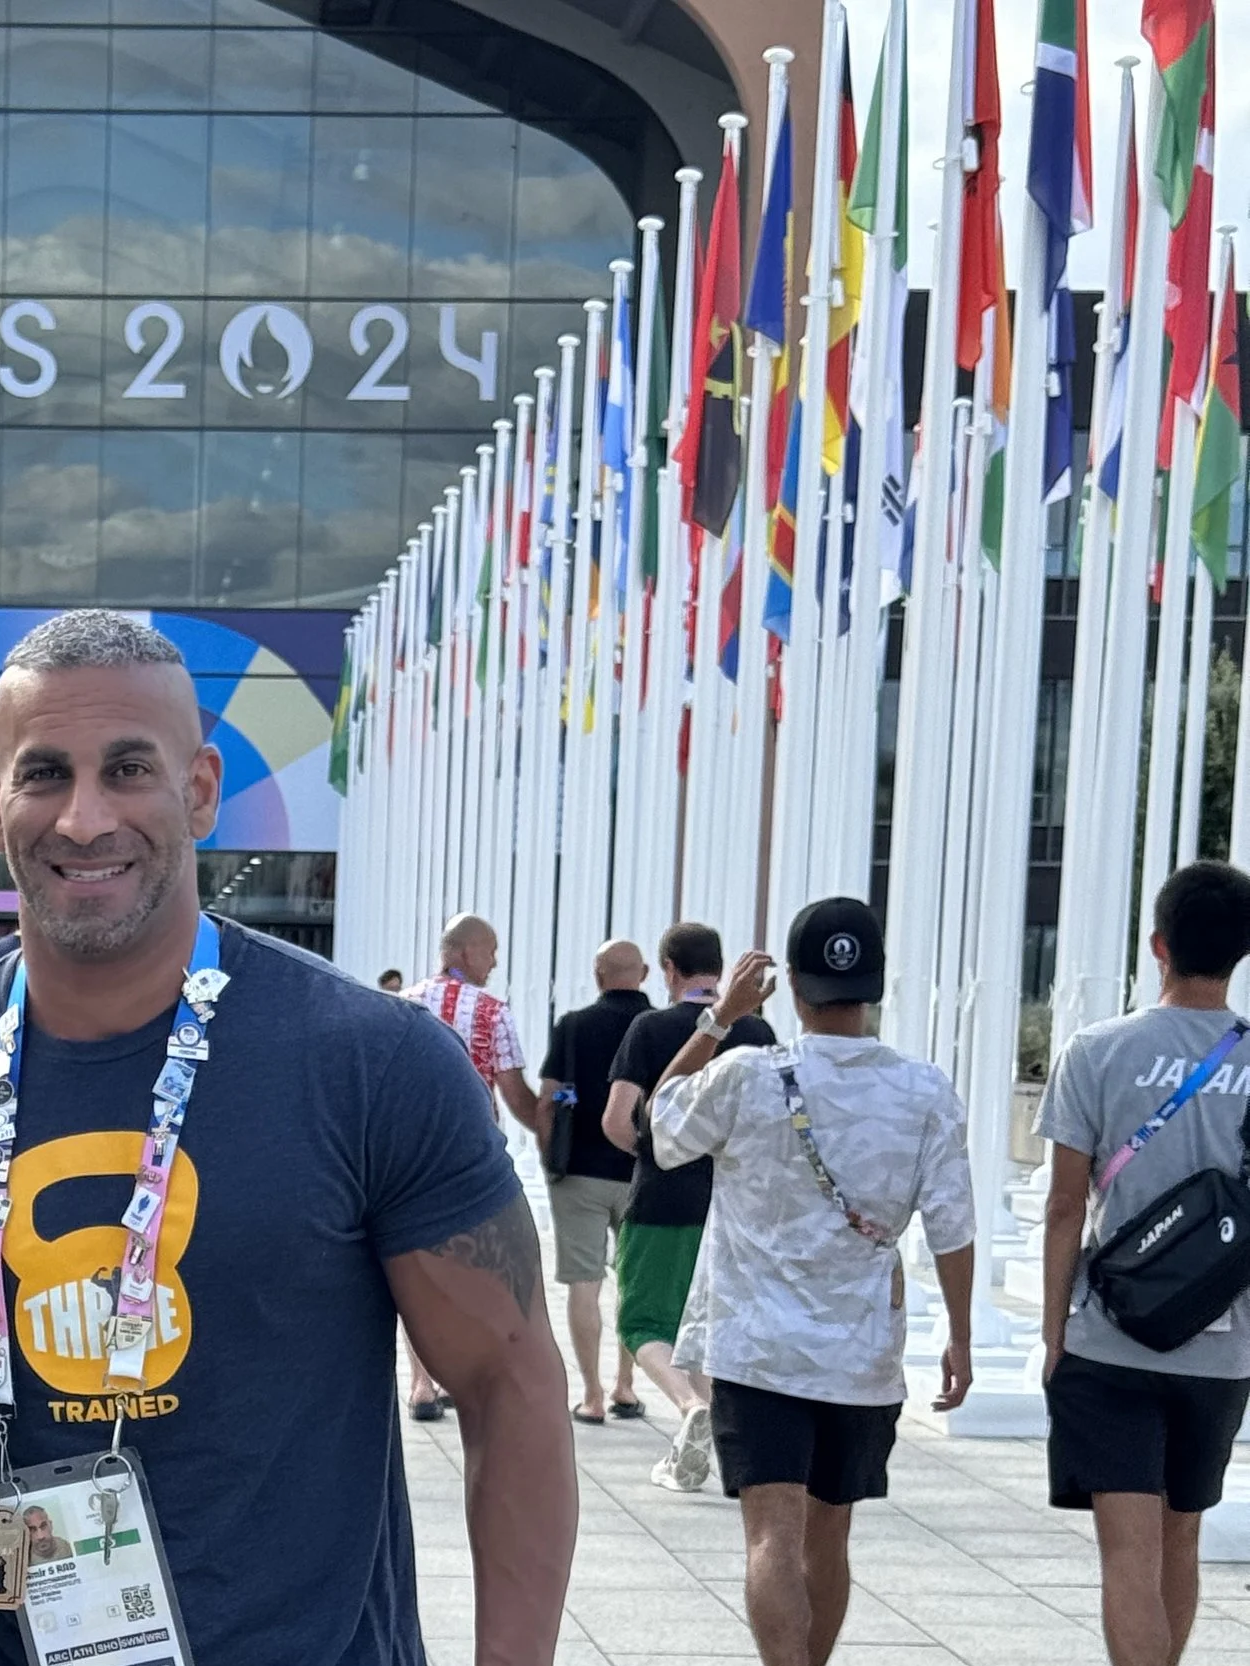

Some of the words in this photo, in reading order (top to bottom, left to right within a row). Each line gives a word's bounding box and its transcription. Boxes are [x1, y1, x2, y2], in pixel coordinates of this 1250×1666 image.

[122, 302, 499, 402] 2024
[1136, 1204, 1184, 1255] JAPAN
[47, 1394, 180, 1423] TRAINED
[47, 1651, 70, 1665] ARC
[71, 1646, 94, 1660] ATH
[97, 1640, 119, 1654] SHO
[120, 1634, 145, 1648] SWM
[145, 1629, 168, 1643] WRE
